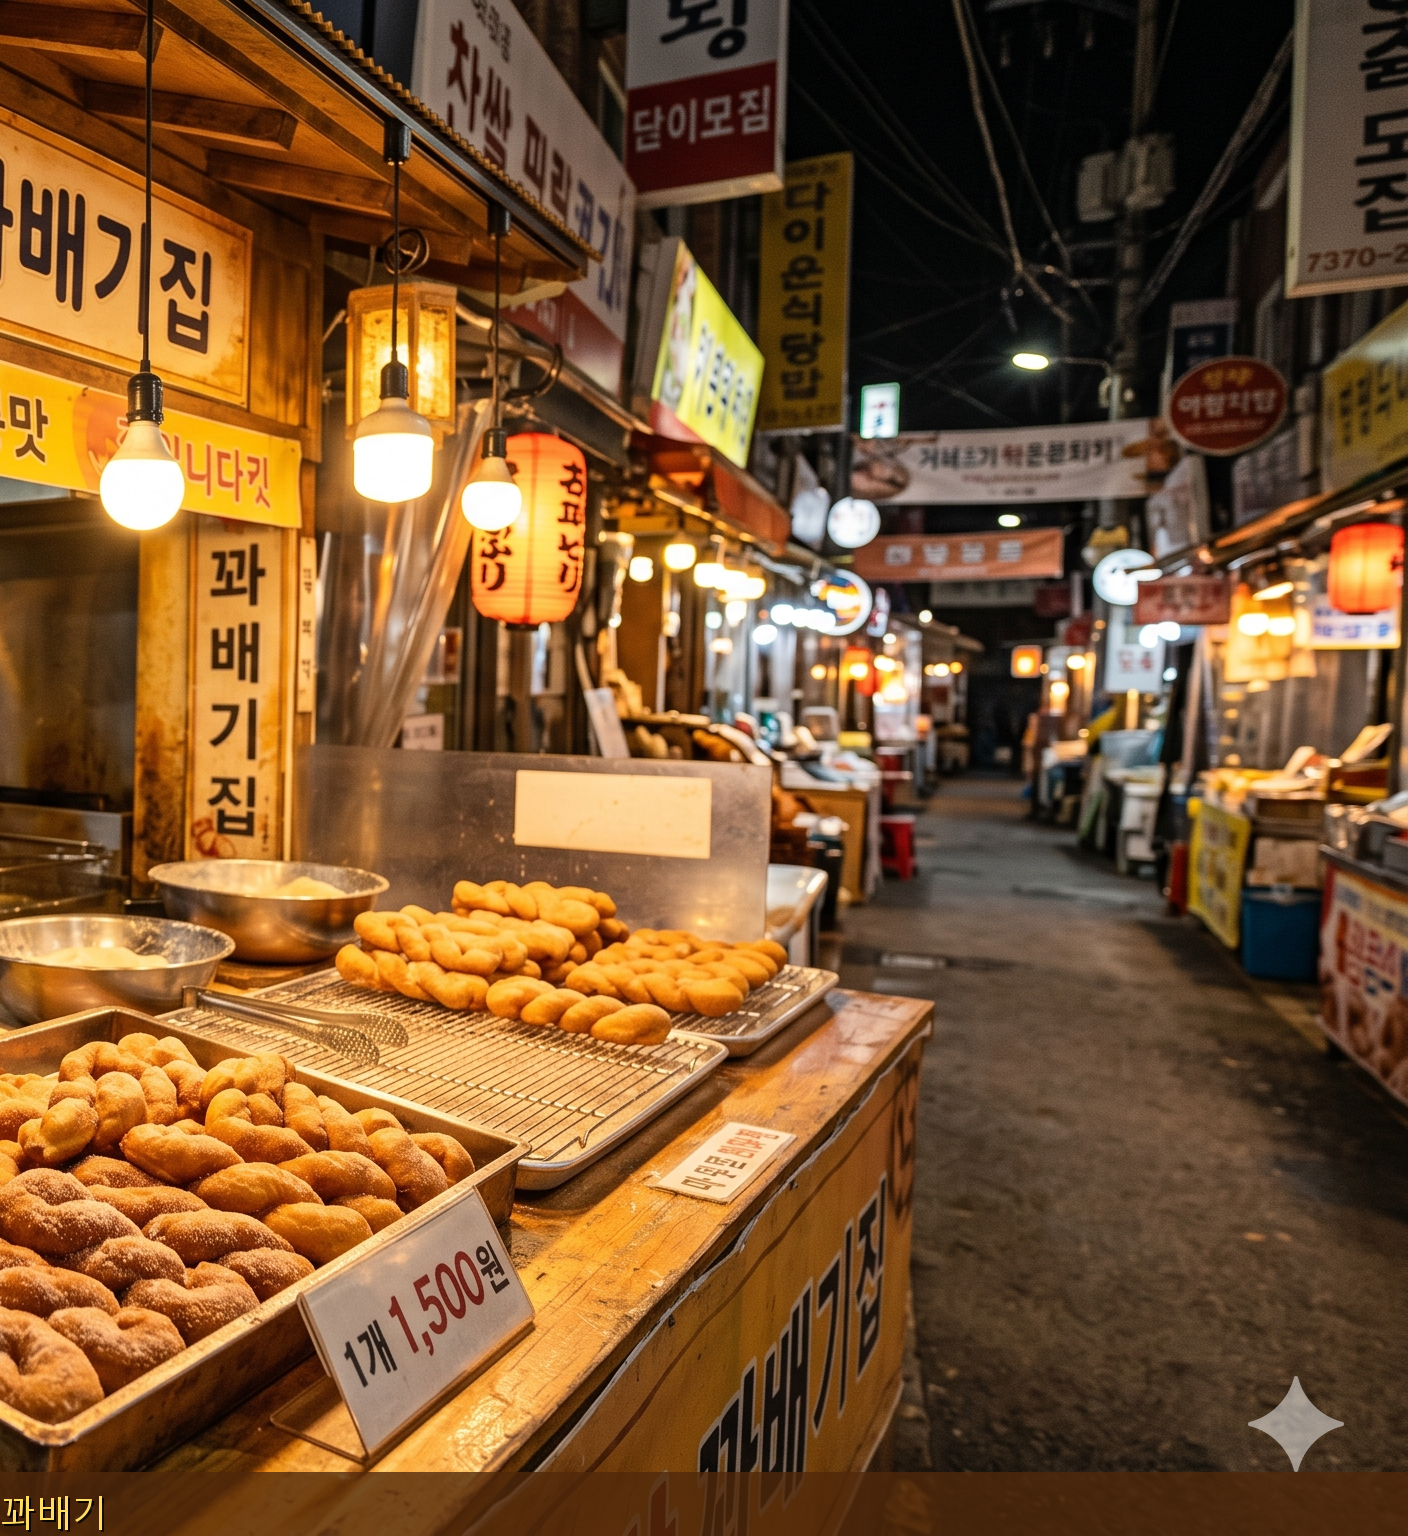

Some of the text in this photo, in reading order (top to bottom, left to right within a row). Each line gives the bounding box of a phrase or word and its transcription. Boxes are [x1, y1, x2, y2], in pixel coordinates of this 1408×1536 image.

[208, 543, 266, 838] 꽈배기집
[344, 1240, 510, 1388] 1개 1,500원
